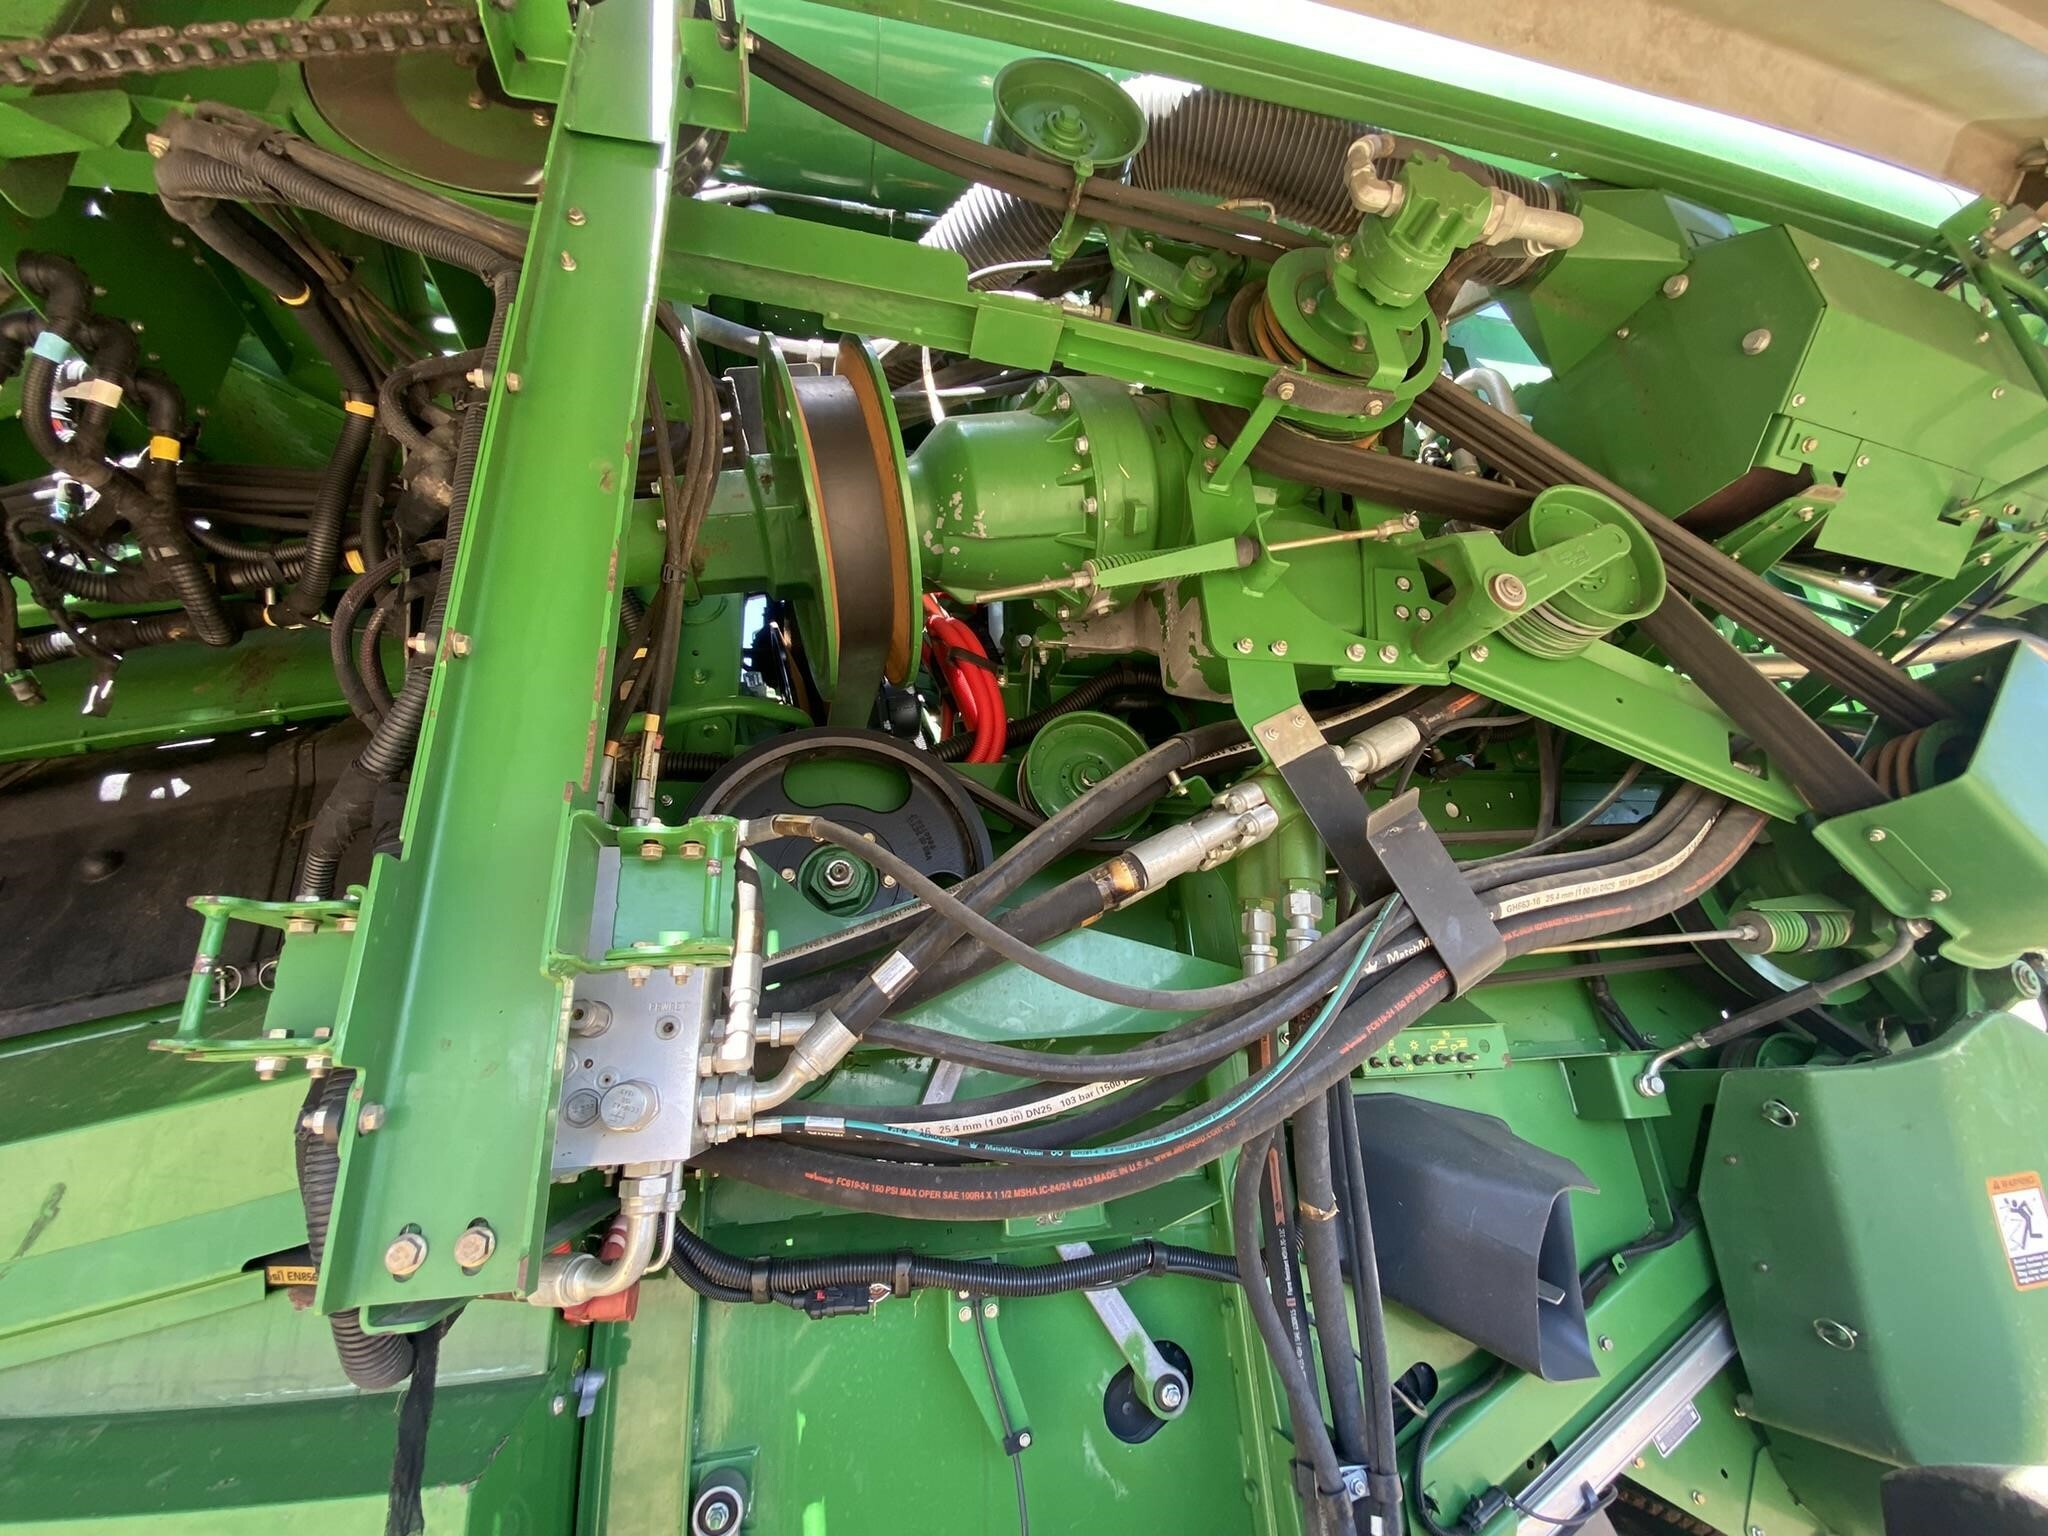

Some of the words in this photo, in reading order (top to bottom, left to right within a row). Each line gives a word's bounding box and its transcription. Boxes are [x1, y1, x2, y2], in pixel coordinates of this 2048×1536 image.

[962, 1121, 983, 1131] mm
[985, 1115, 1009, 1129] (1.00
[1010, 1110, 1025, 1123] in)
[1026, 1104, 1053, 1119] DN25
[1060, 1096, 1077, 1108] 103
[1078, 1089, 1094, 1102] bar
[885, 1185, 899, 1195] PSI
[899, 1187, 917, 1198] MAX
[919, 1188, 942, 1200] OPER
[942, 1189, 959, 1200] SAE
[986, 1190, 993, 1200] X
[1000, 1189, 1013, 1199] 1/2
[1013, 1187, 1039, 1198] MSHA
[1094, 1168, 1119, 1184] MADE
[1119, 1165, 1129, 1177] IN
